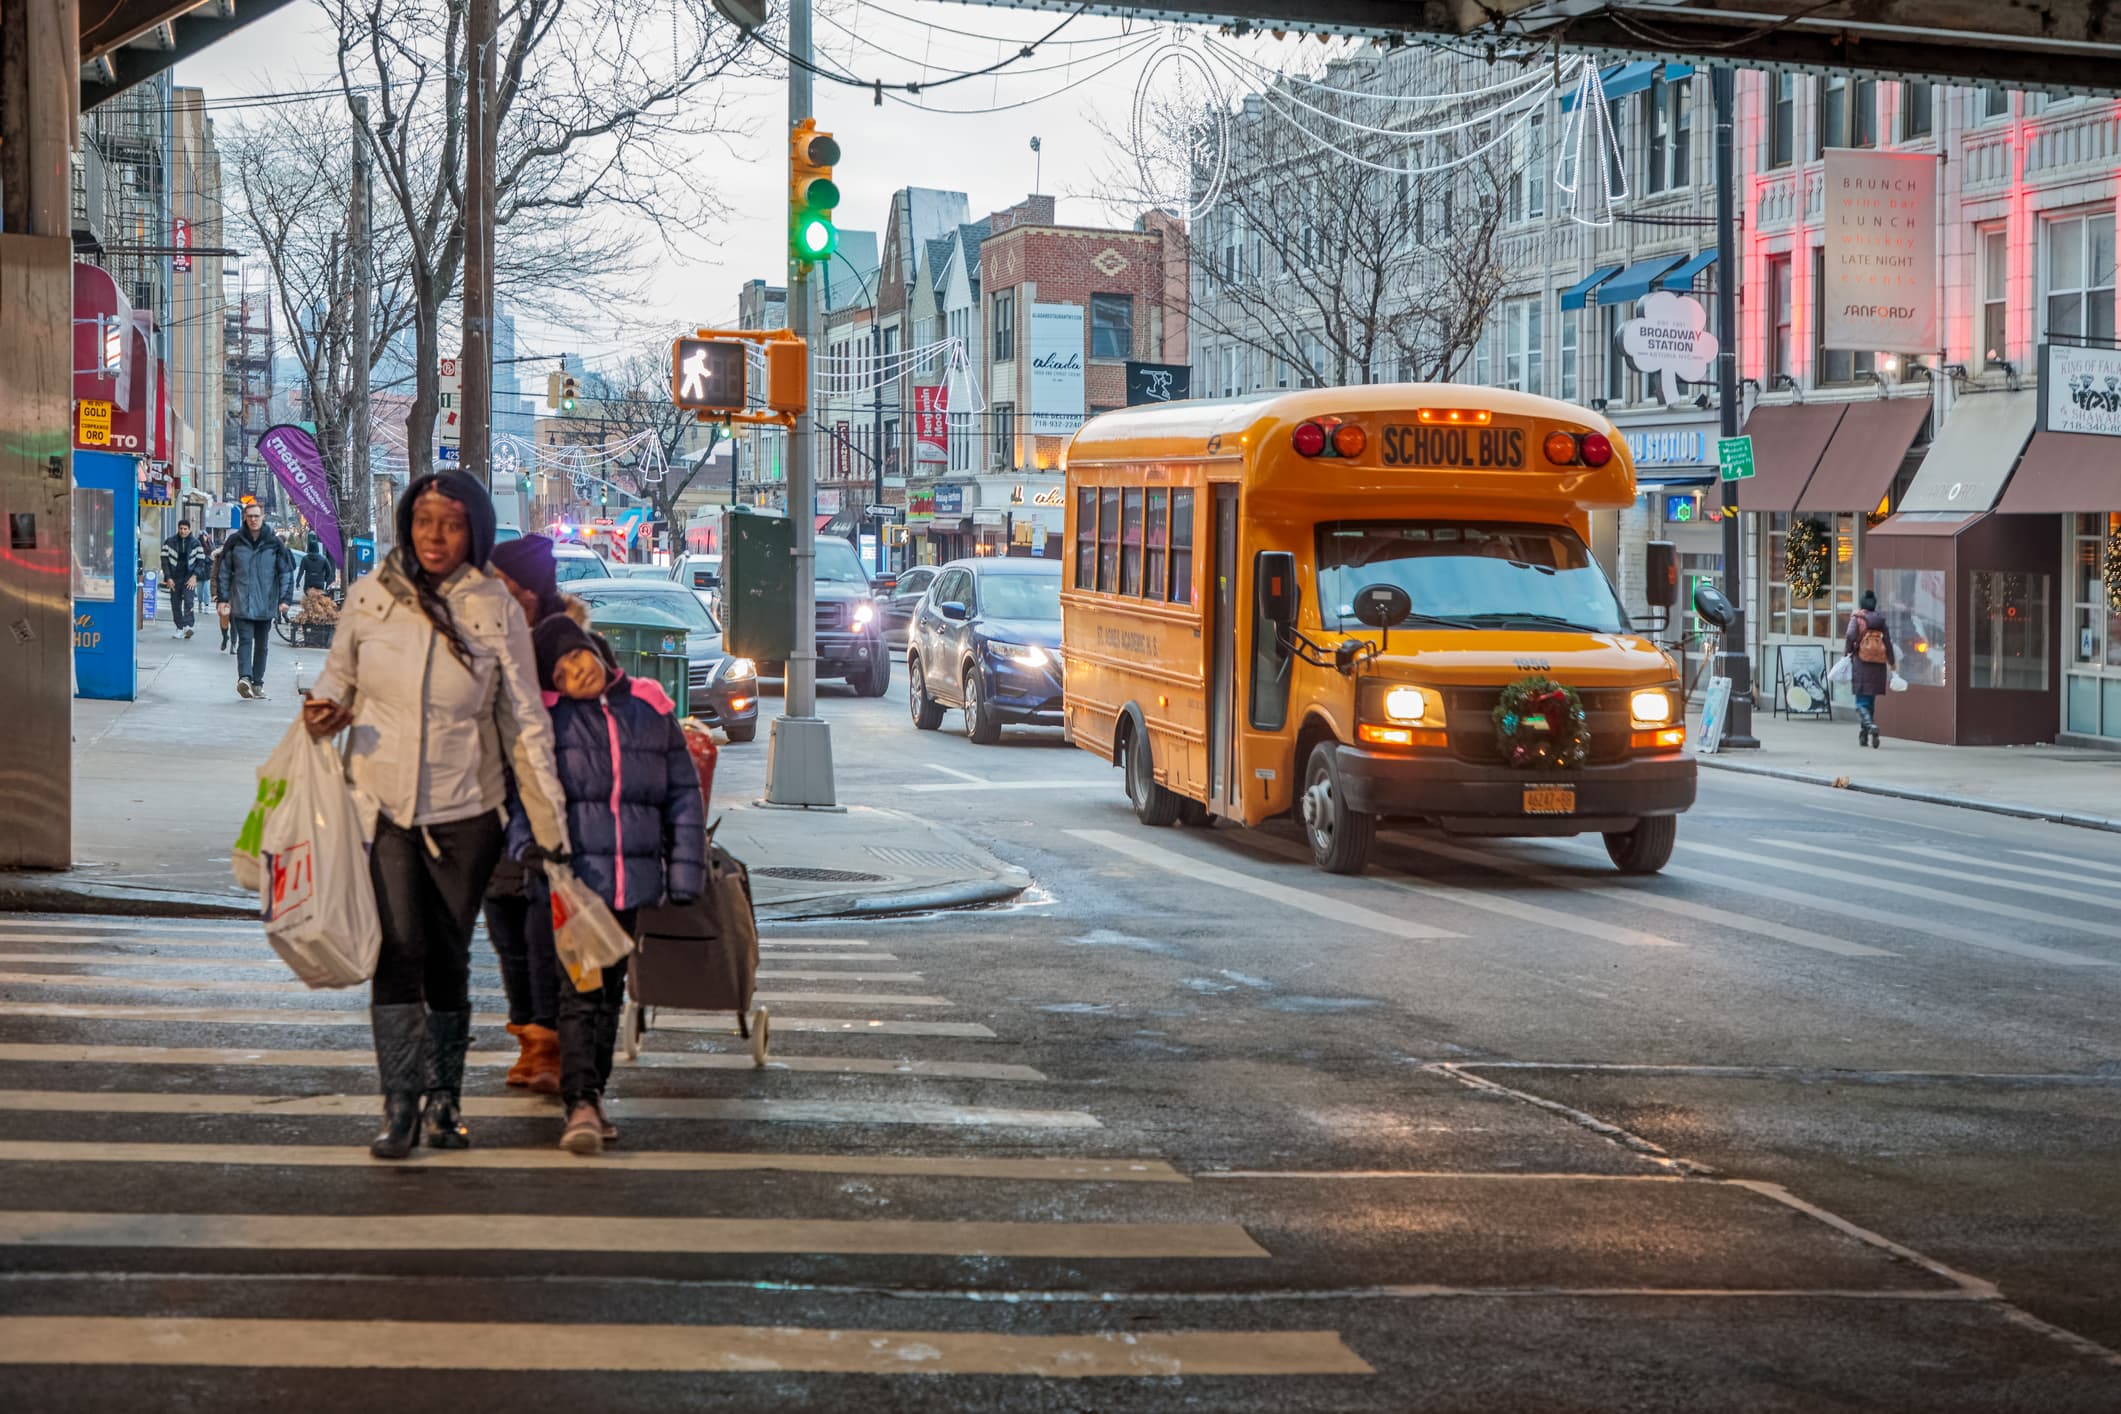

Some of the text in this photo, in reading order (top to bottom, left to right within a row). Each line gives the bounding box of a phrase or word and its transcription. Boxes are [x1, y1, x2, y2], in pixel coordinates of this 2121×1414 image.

[1843, 177, 1916, 191] BRUNCH
[1842, 215, 1915, 228] LUNCH
[1841, 254, 1914, 267] LATE NIGHT
[1843, 304, 1916, 319] SANFORDS
[1640, 327, 1702, 342] BROADWAY
[1648, 339, 1693, 352] STATION
[1033, 352, 1081, 370] aliada
[2061, 360, 2081, 375] KING
[2084, 360, 2096, 373] OF
[84, 407, 107, 417] GOLD
[921, 388, 933, 437] Benjamin
[86, 430, 104, 440] ORO
[1385, 427, 1522, 467] SCHOOL BUS
[1647, 432, 1702, 462] STATION
[271, 436, 307, 484] metro
